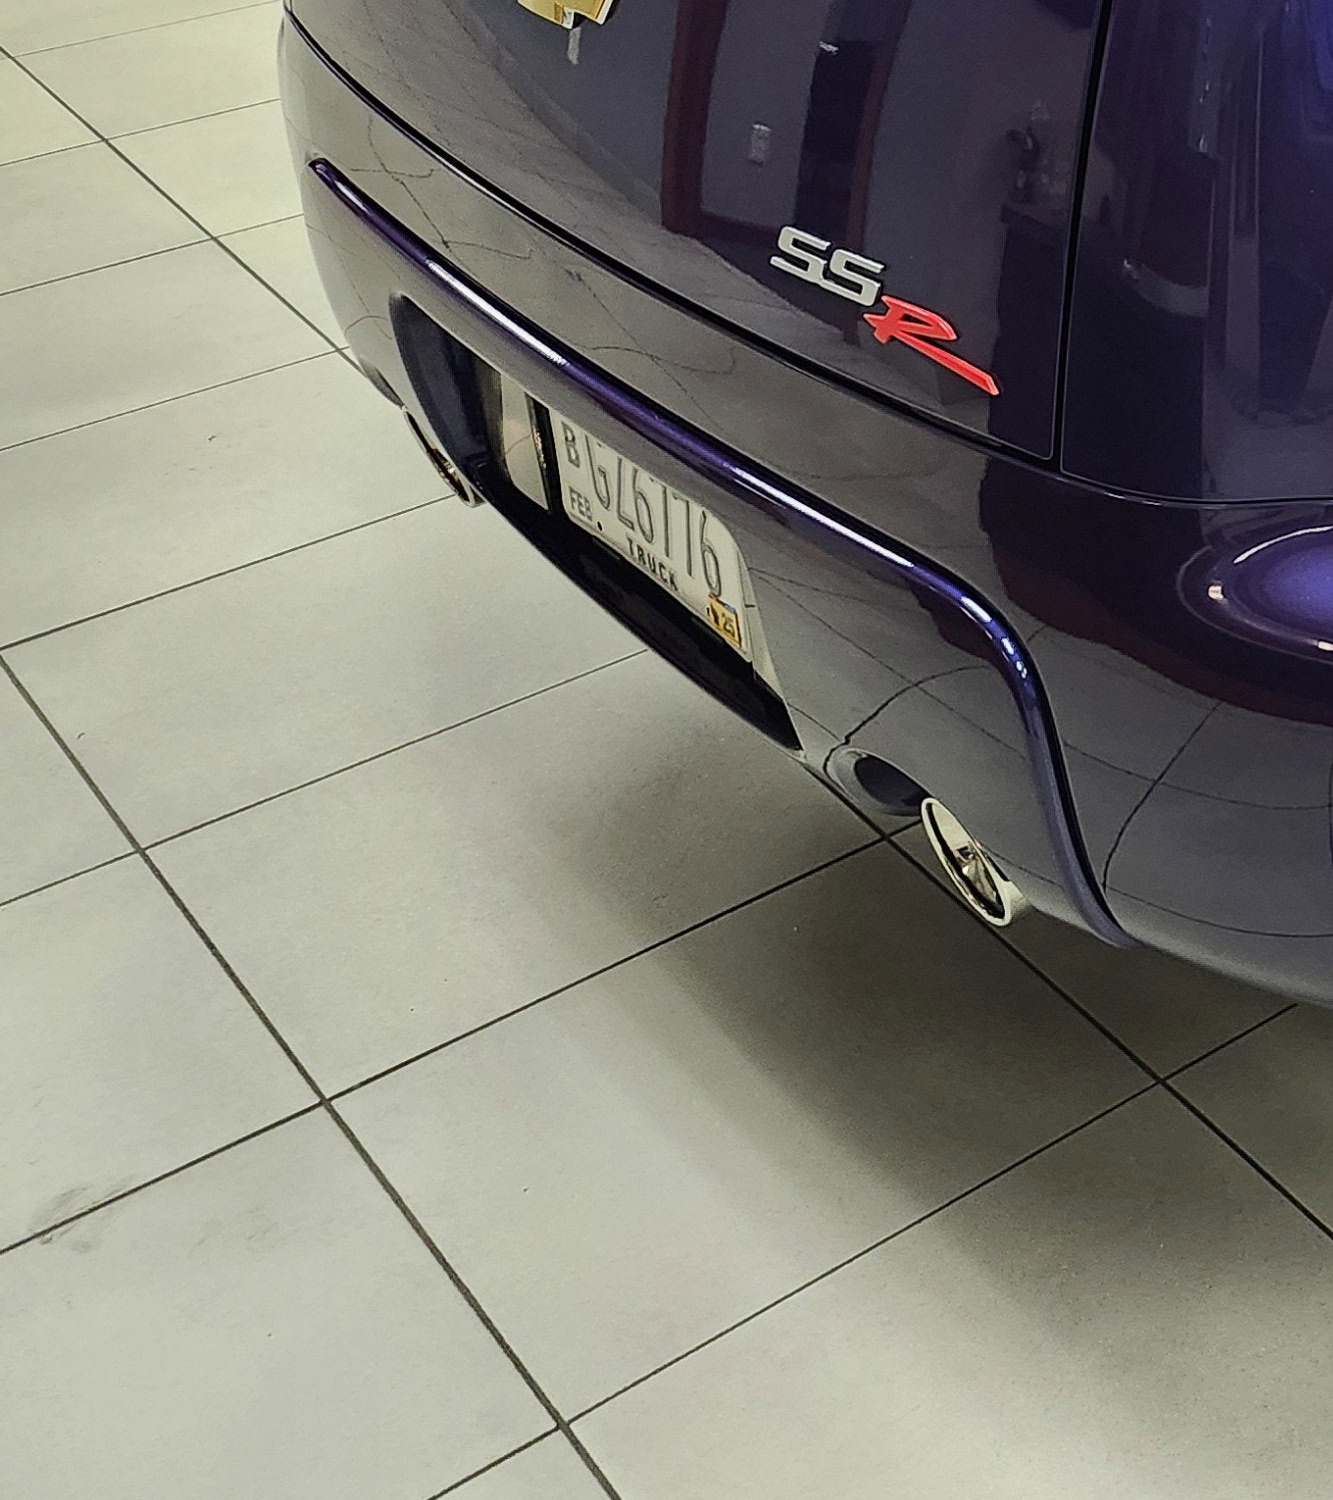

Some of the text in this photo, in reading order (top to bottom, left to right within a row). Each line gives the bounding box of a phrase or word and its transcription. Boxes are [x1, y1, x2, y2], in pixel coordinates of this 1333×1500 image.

[561, 420, 580, 468] B
[568, 485, 593, 522] FEB
[625, 532, 680, 593] TRUCK
